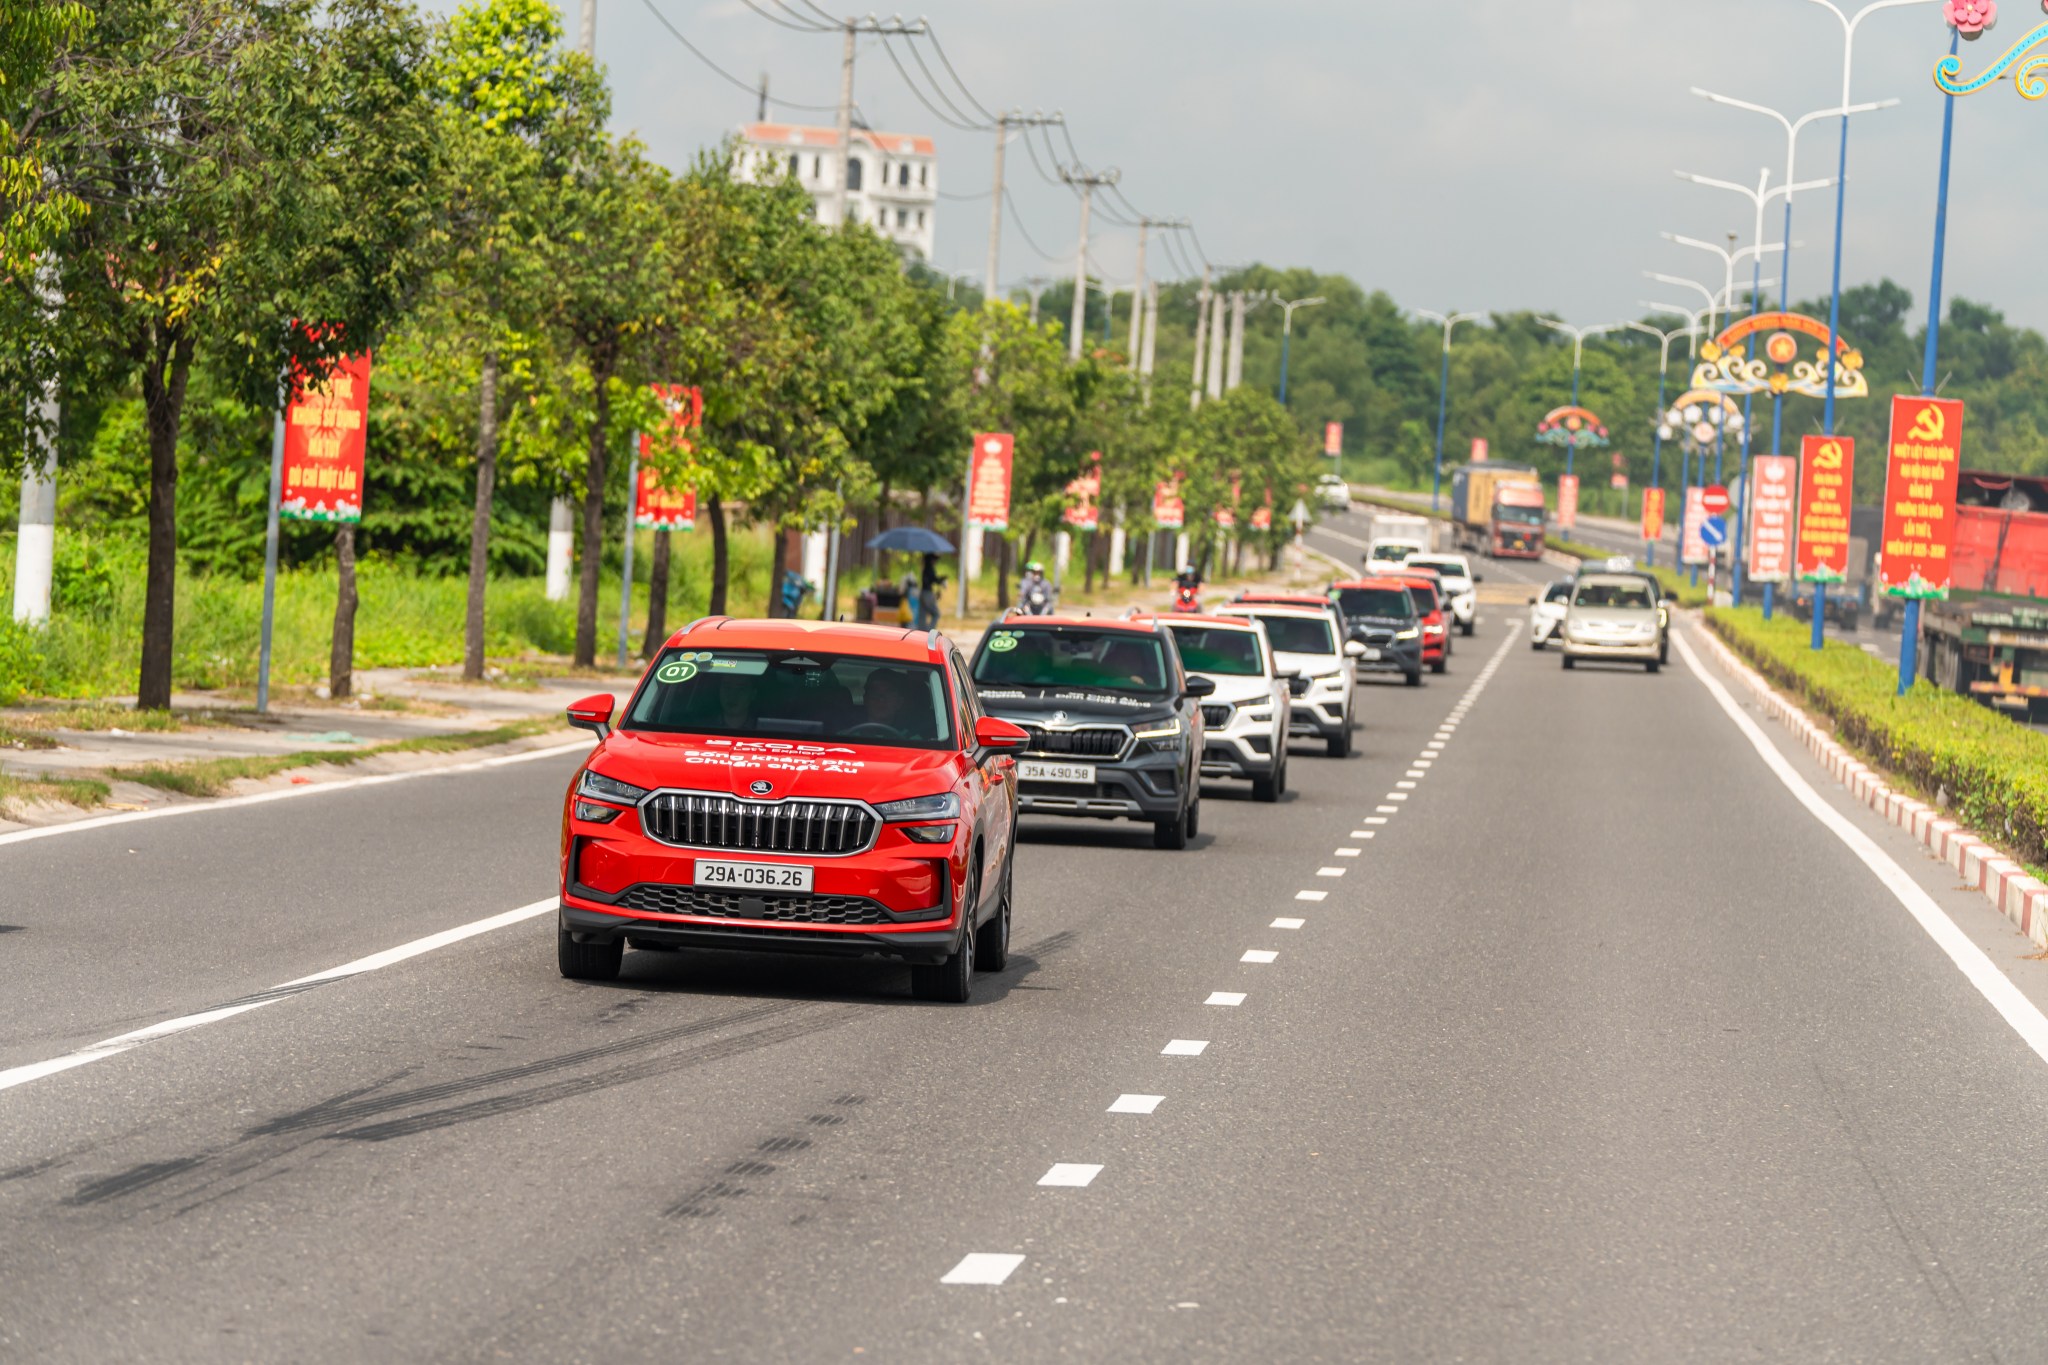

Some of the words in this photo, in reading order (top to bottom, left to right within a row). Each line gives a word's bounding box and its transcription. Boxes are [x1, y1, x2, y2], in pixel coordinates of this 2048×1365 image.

[993, 639, 1012, 648] 02
[666, 666, 689, 677] 01
[771, 748, 826, 757] Explore
[684, 750, 745, 762] Sống
[751, 754, 815, 764] khám
[821, 759, 865, 768] phá
[767, 762, 820, 772] chất
[823, 765, 858, 775] Âu
[704, 866, 802, 886] 29A-036.26
